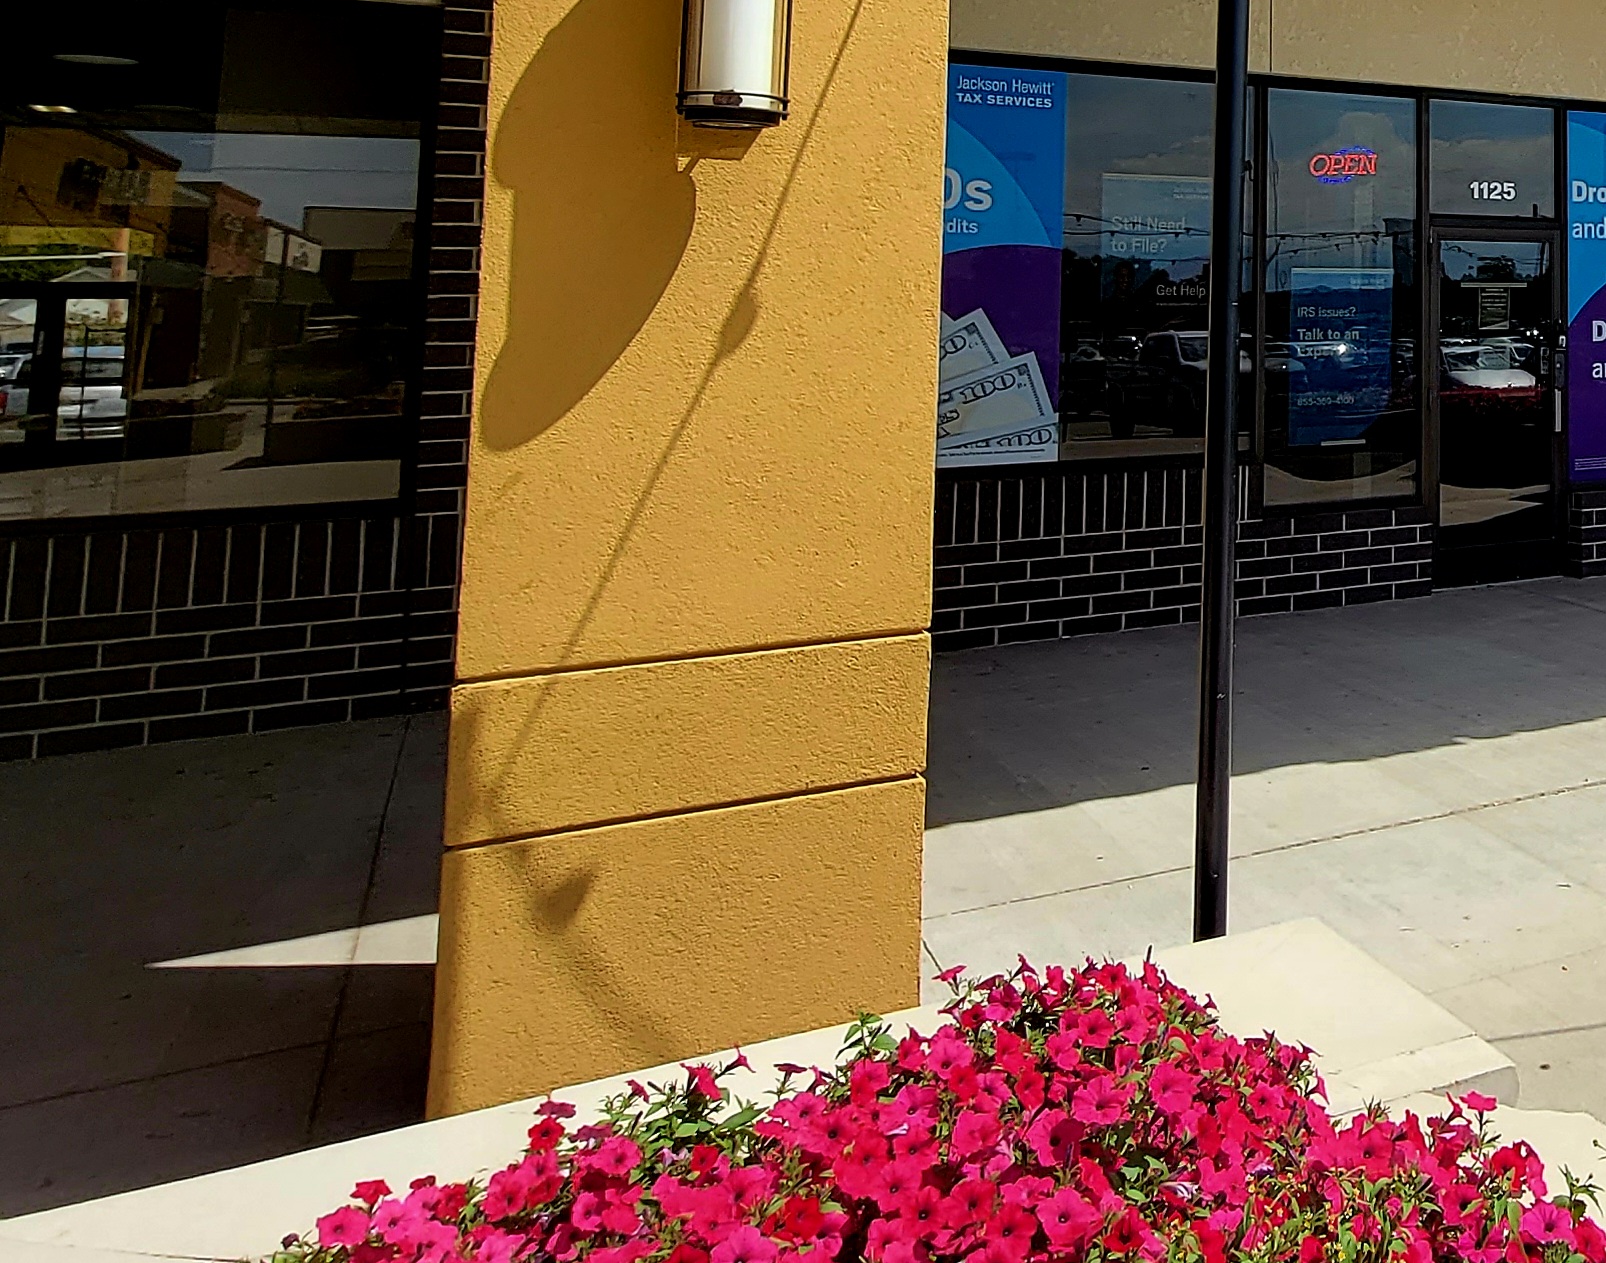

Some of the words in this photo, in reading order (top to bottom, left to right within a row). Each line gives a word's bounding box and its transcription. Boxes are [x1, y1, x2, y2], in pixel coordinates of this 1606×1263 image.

[956, 75, 1008, 92] Jackson
[1012, 78, 1053, 96] Hewitt
[956, 92, 983, 104] TAX
[986, 94, 1053, 109] SERVICES
[1308, 153, 1378, 177] OPEN
[1469, 181, 1517, 200] 1125
[1111, 216, 1142, 231] Still
[1147, 216, 1186, 232] Need
[1110, 239, 1127, 252] to
[1132, 238, 1167, 254] File?
[1156, 284, 1178, 296] Get
[1180, 284, 1206, 299] Help
[1297, 306, 1316, 318] IRS
[1318, 306, 1357, 318] issues?
[1296, 328, 1326, 341] Talk
[1327, 329, 1341, 340] to
[1343, 330, 1360, 340] an
